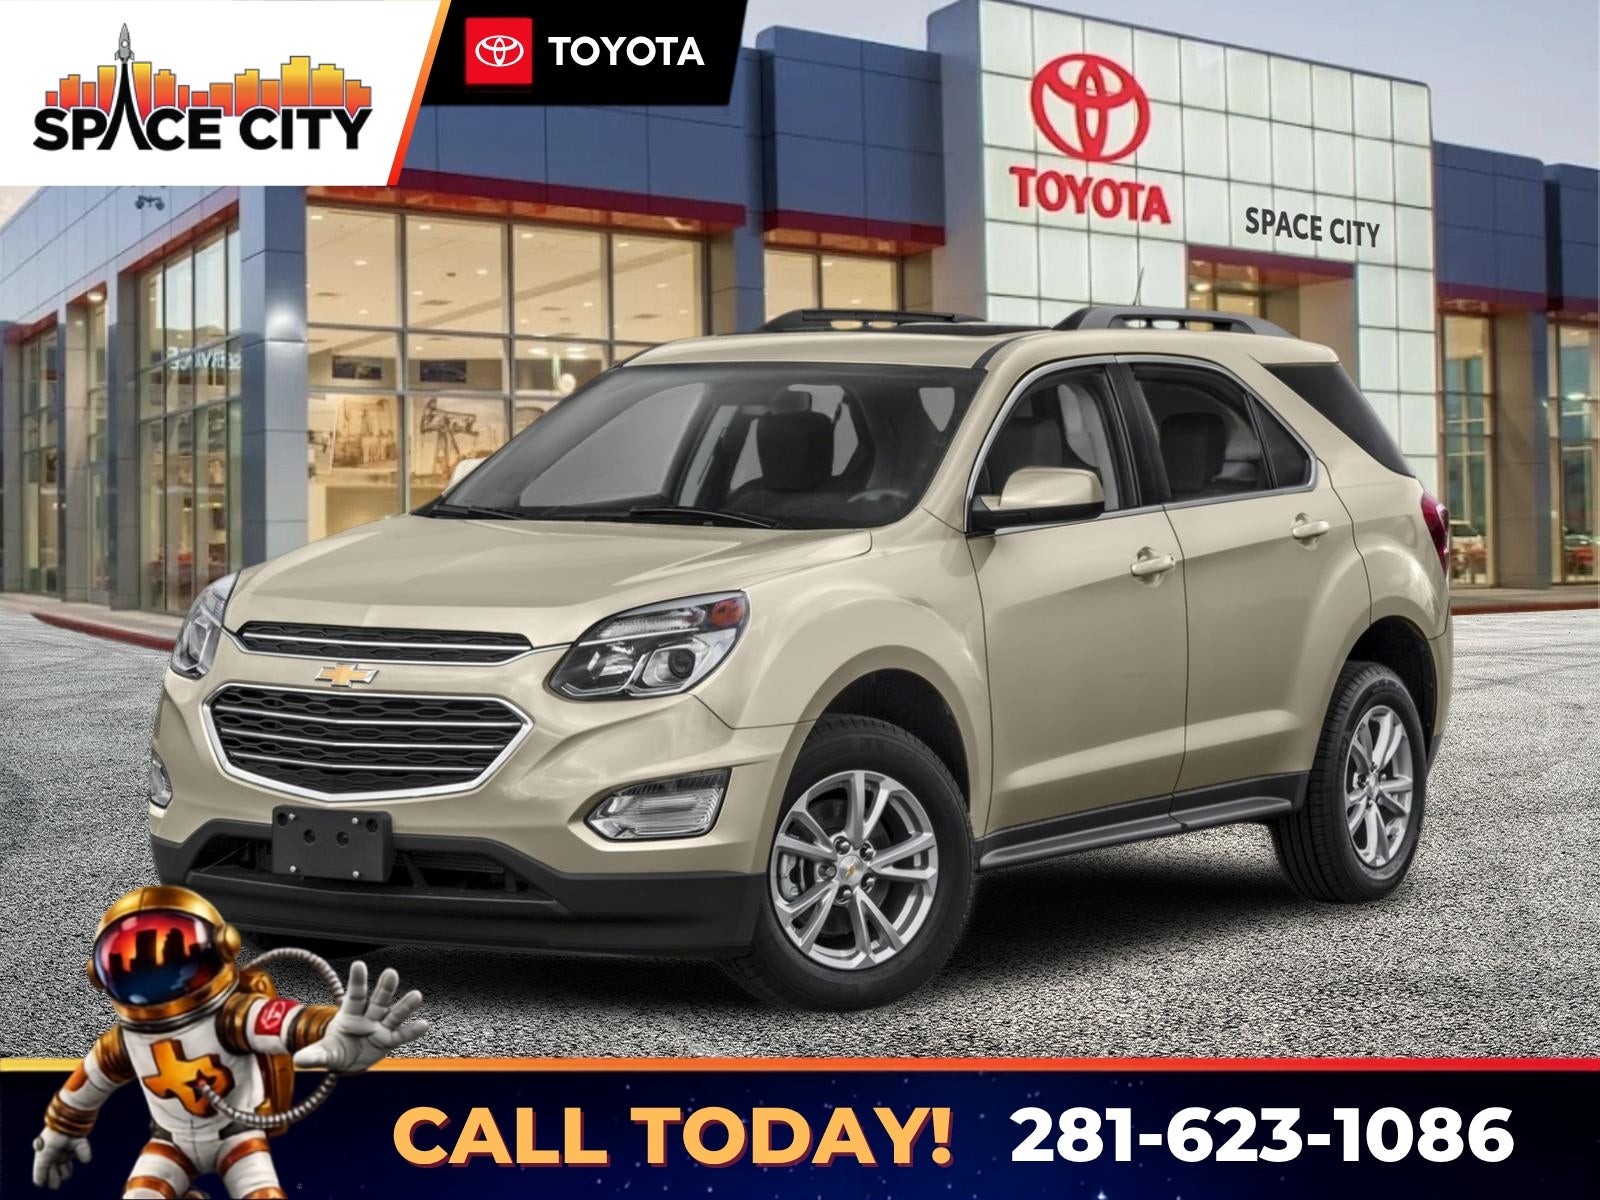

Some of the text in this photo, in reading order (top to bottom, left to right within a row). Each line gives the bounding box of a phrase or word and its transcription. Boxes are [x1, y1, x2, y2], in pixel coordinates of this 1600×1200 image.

[1009, 166, 1171, 224] TOYOTA
[1245, 206, 1380, 248] SPACE CITY
